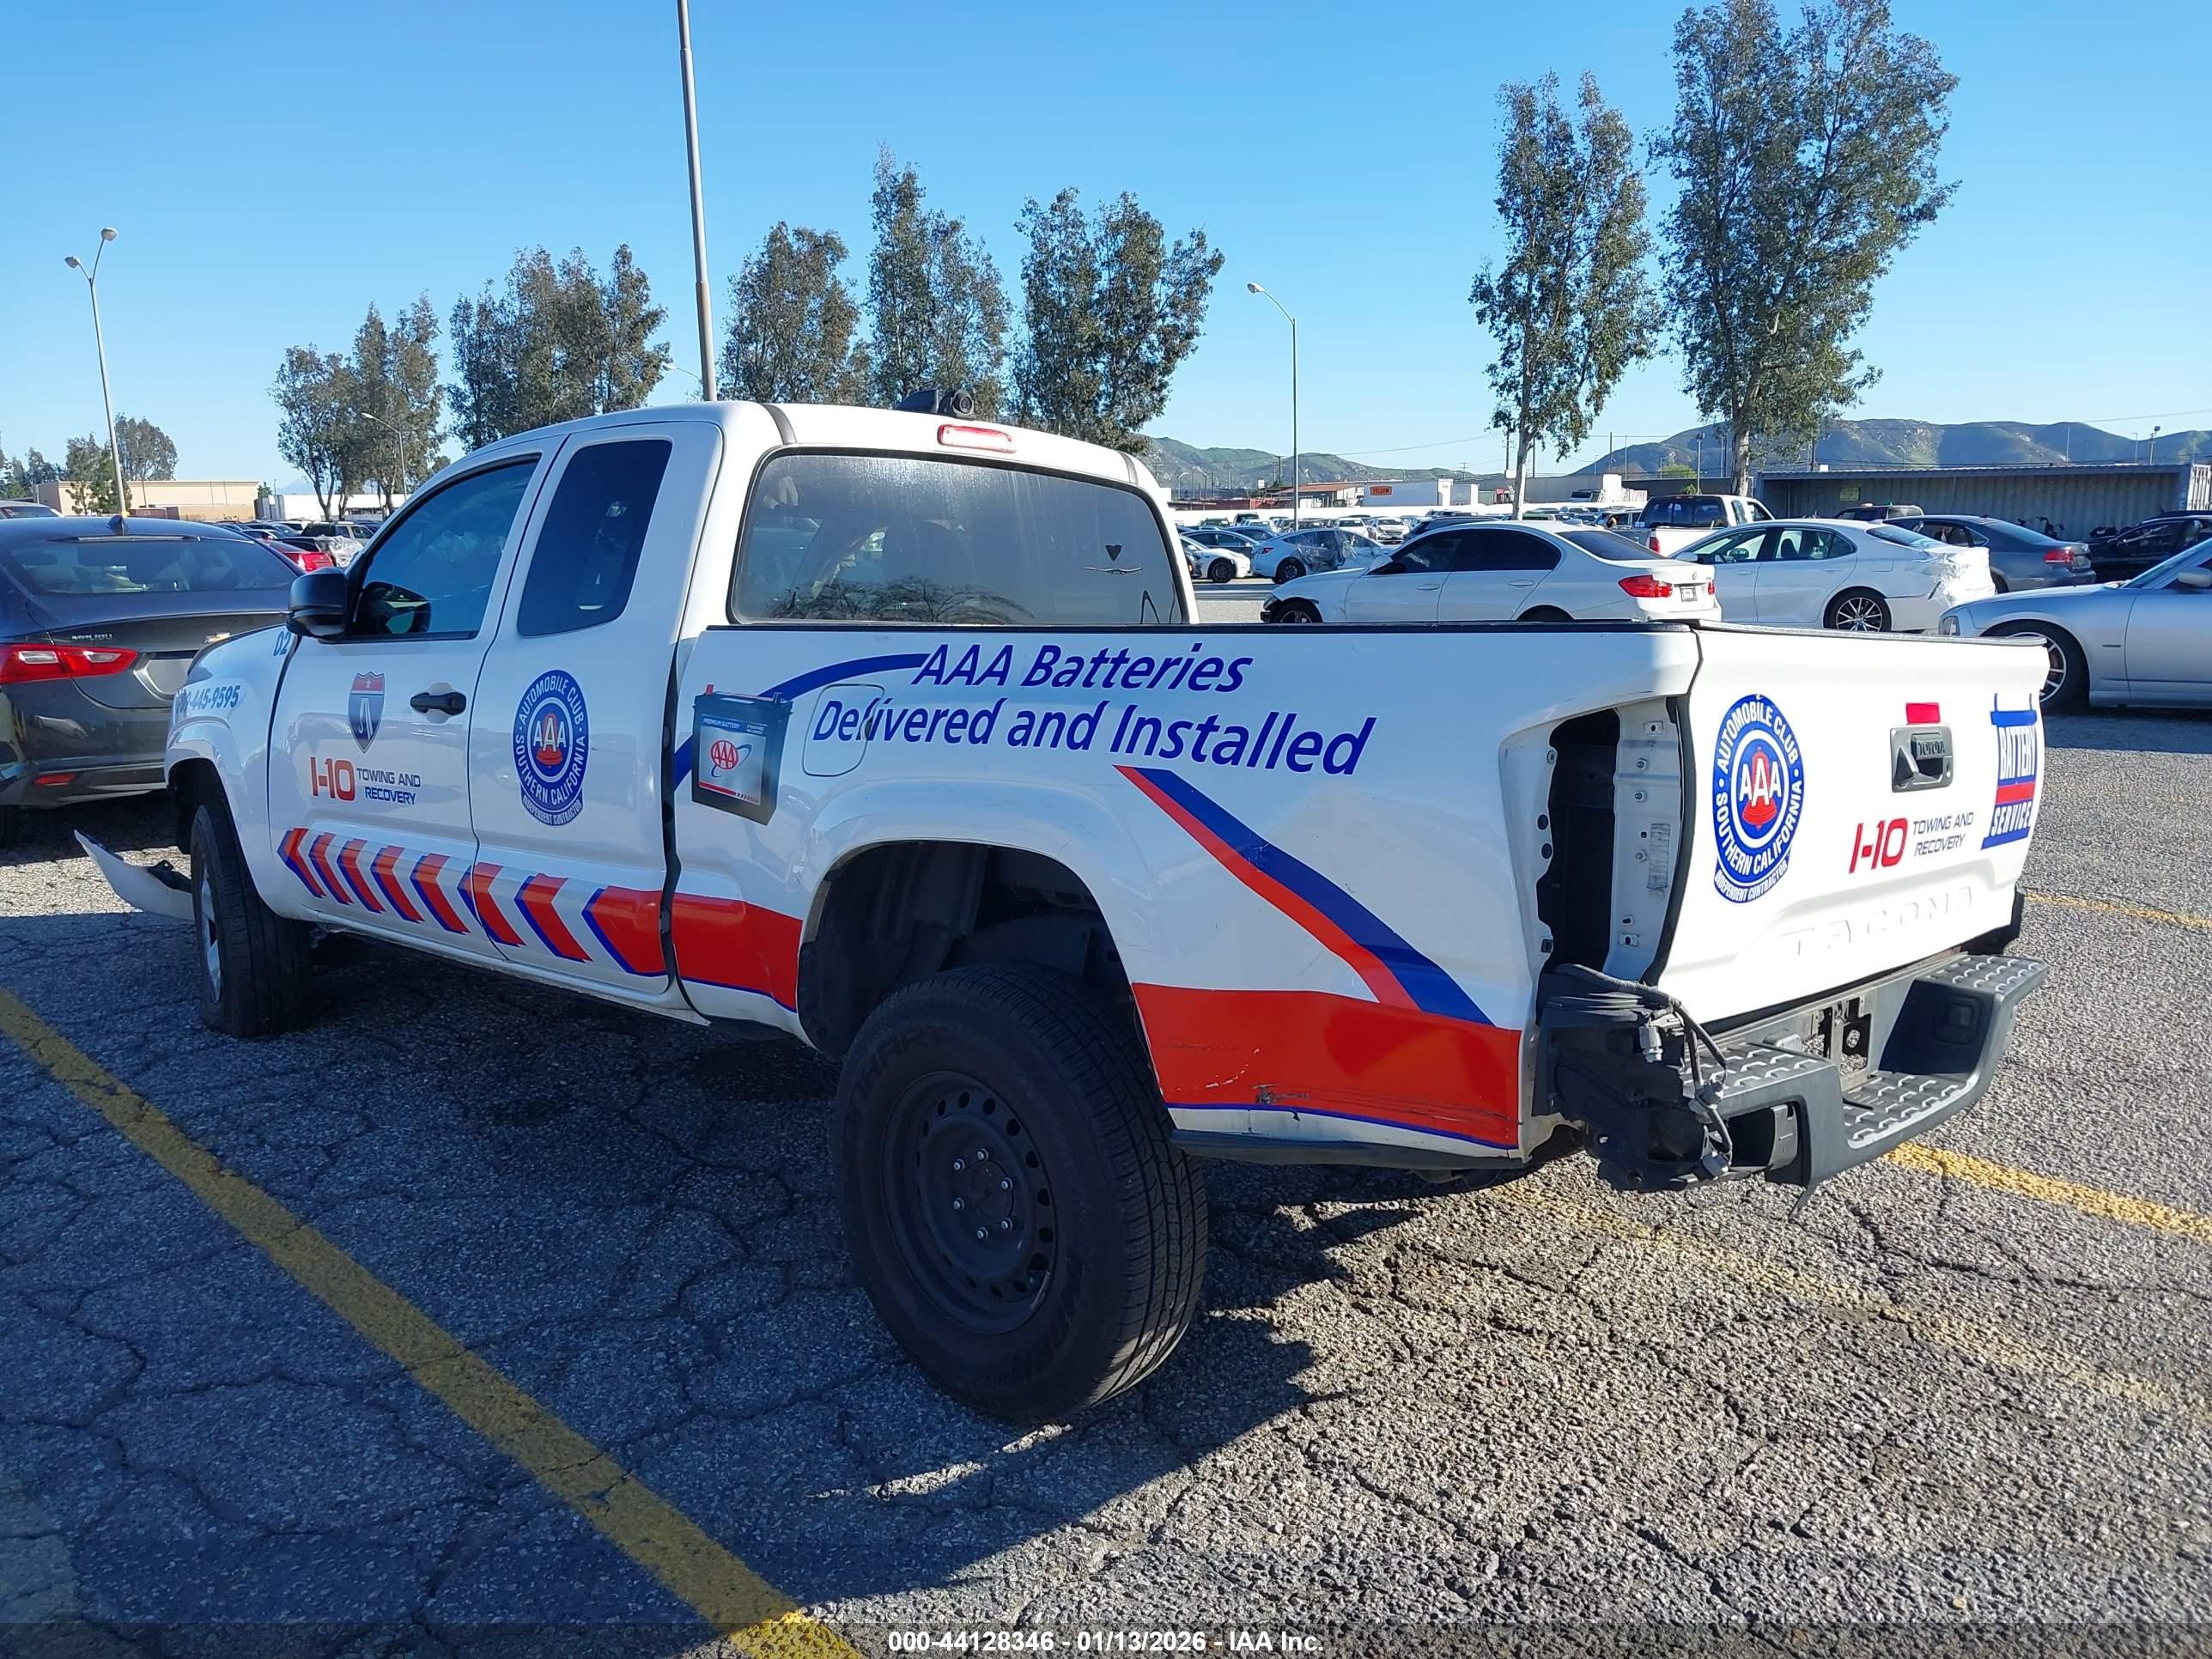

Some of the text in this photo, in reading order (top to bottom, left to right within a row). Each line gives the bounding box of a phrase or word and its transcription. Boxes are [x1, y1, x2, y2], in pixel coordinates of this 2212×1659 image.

[273, 630, 292, 657] 02
[911, 642, 1255, 693] AAA Batteries
[520, 675, 585, 726] AUTOMOBILE CLUB
[532, 717, 567, 752] AAA
[712, 741, 738, 769] AAA
[811, 697, 1377, 776] Delivered and Installed
[1717, 701, 1799, 775] AUTOMOBILE CLUB
[1917, 739, 1946, 757] TOYOTA
[1998, 726, 2035, 781] BATTERY
[310, 756, 356, 802] I-10
[356, 768, 421, 787] TOWING AND
[515, 734, 586, 806] SOUTHERN CALIFORNIA
[1738, 757, 1783, 807] AAA
[364, 786, 416, 805] RECOVERY
[1716, 792, 1753, 876] SOUTHERN
[1753, 780, 1803, 876] CALIFORNIA
[1912, 811, 1974, 836] TOWING AND
[1990, 800, 2033, 837] SERVICE
[1848, 817, 1909, 874] I-10
[1914, 833, 1966, 857] RECOVERY
[1714, 859, 1788, 902] INDEPENDENT CONTRACTOR
